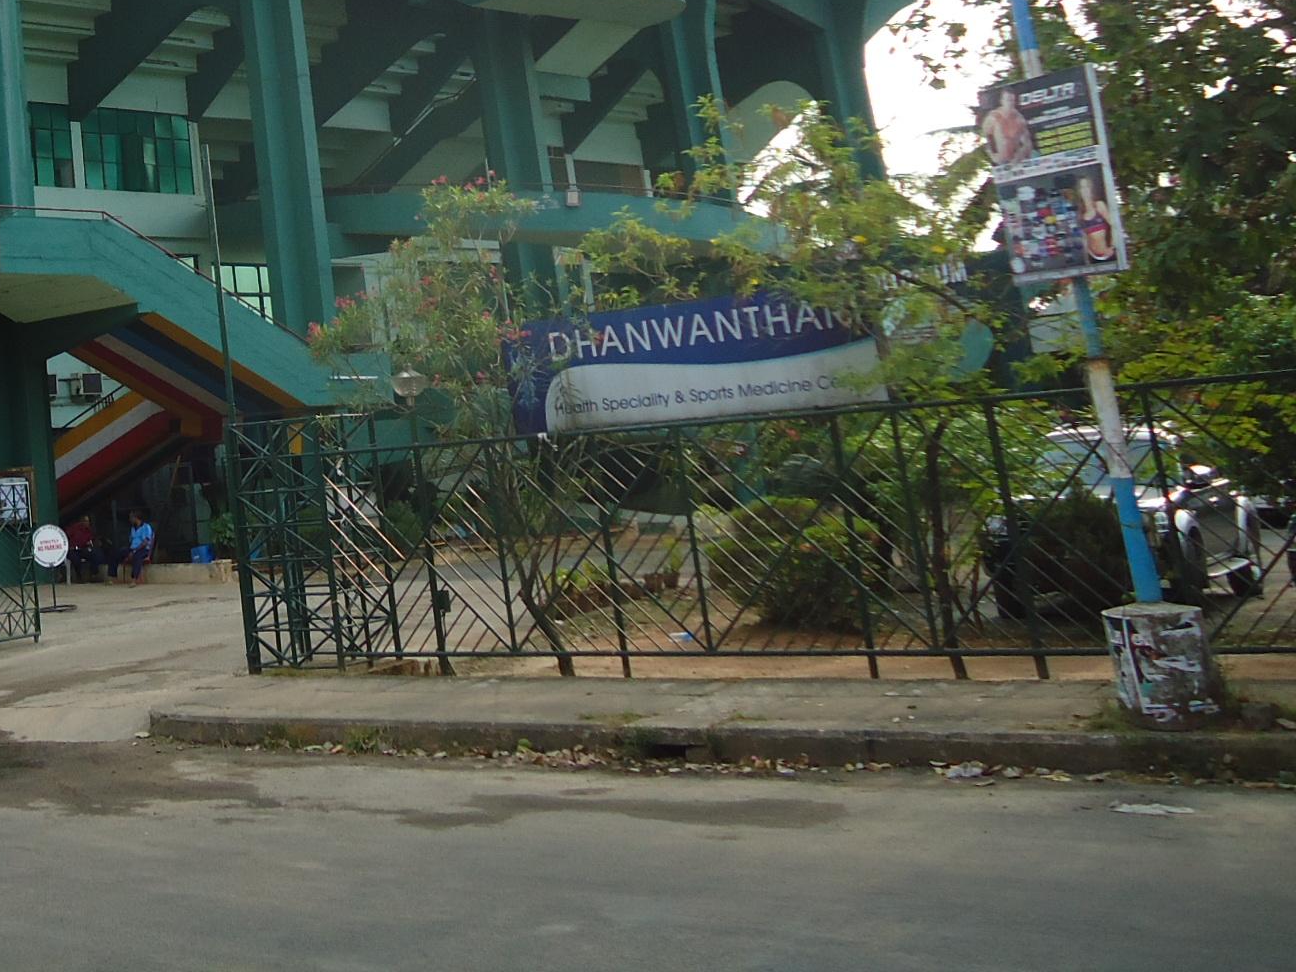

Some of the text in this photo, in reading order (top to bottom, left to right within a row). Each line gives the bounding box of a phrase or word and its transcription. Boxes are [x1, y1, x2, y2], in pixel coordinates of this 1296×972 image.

[602, 391, 670, 413] Speciality
[675, 390, 686, 404] &
[689, 386, 735, 403] Sports
[737, 378, 812, 398] Medicine
